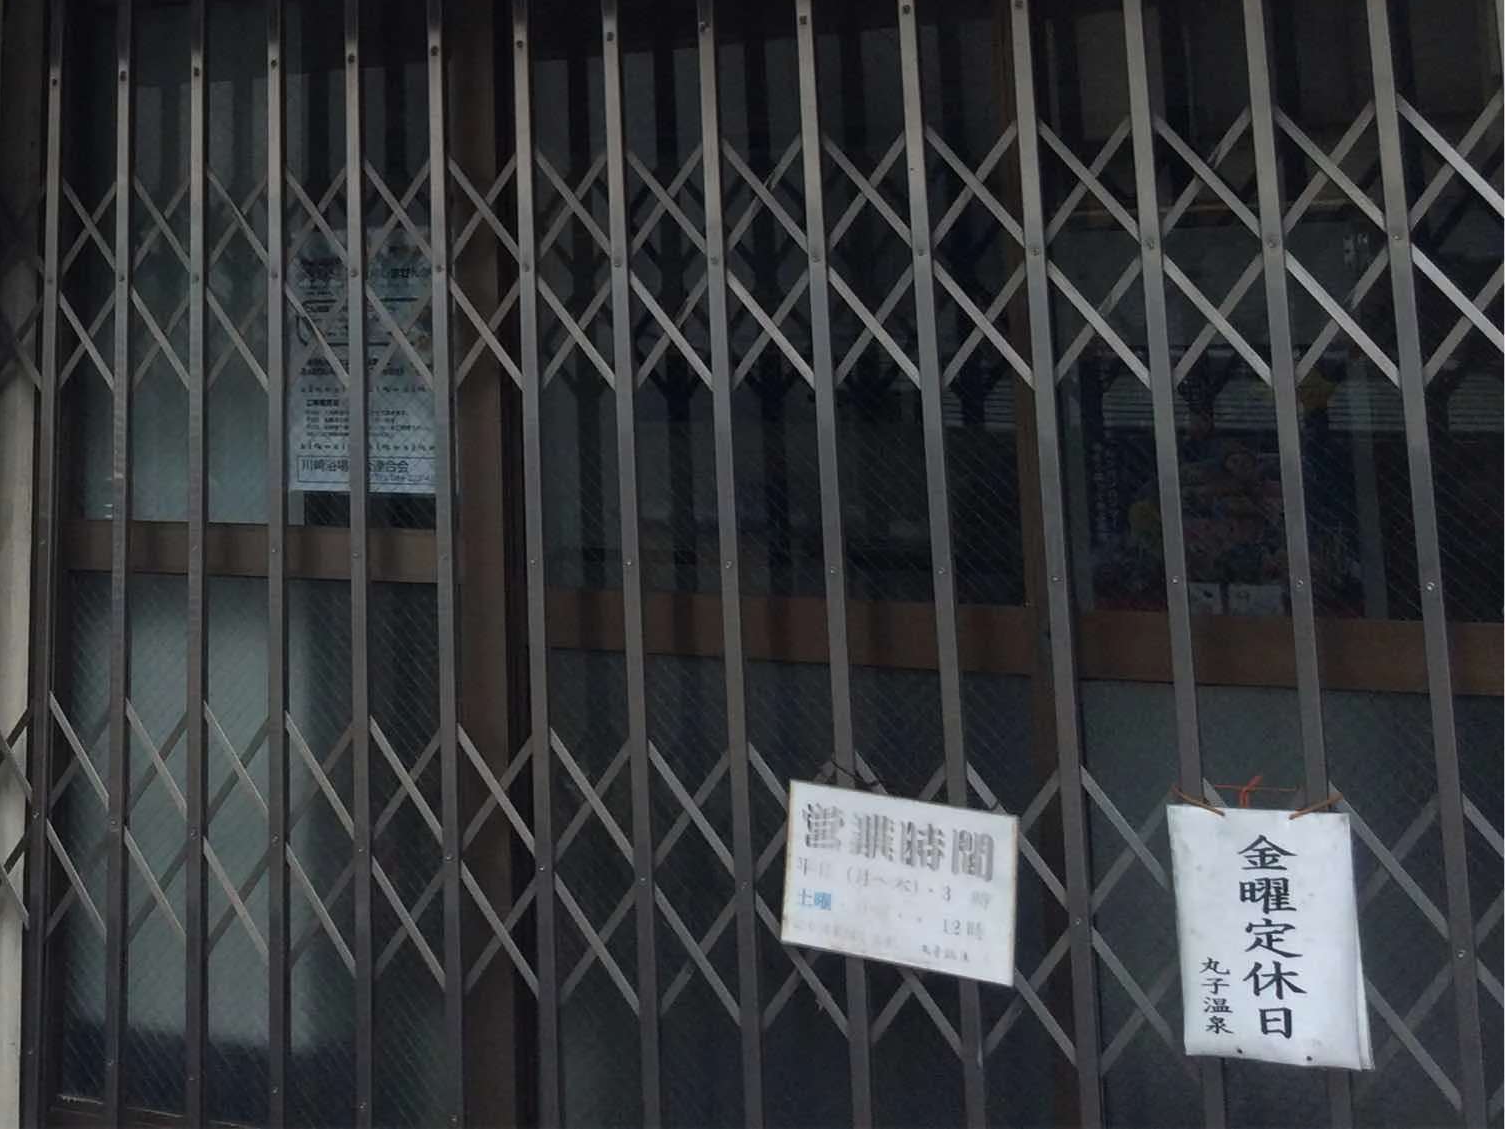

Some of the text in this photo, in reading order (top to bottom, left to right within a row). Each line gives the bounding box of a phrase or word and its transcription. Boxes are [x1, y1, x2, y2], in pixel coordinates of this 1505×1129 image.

[1199, 957, 1235, 1036] 丸子温泉
[1238, 834, 1308, 1040] 金曜定休日
